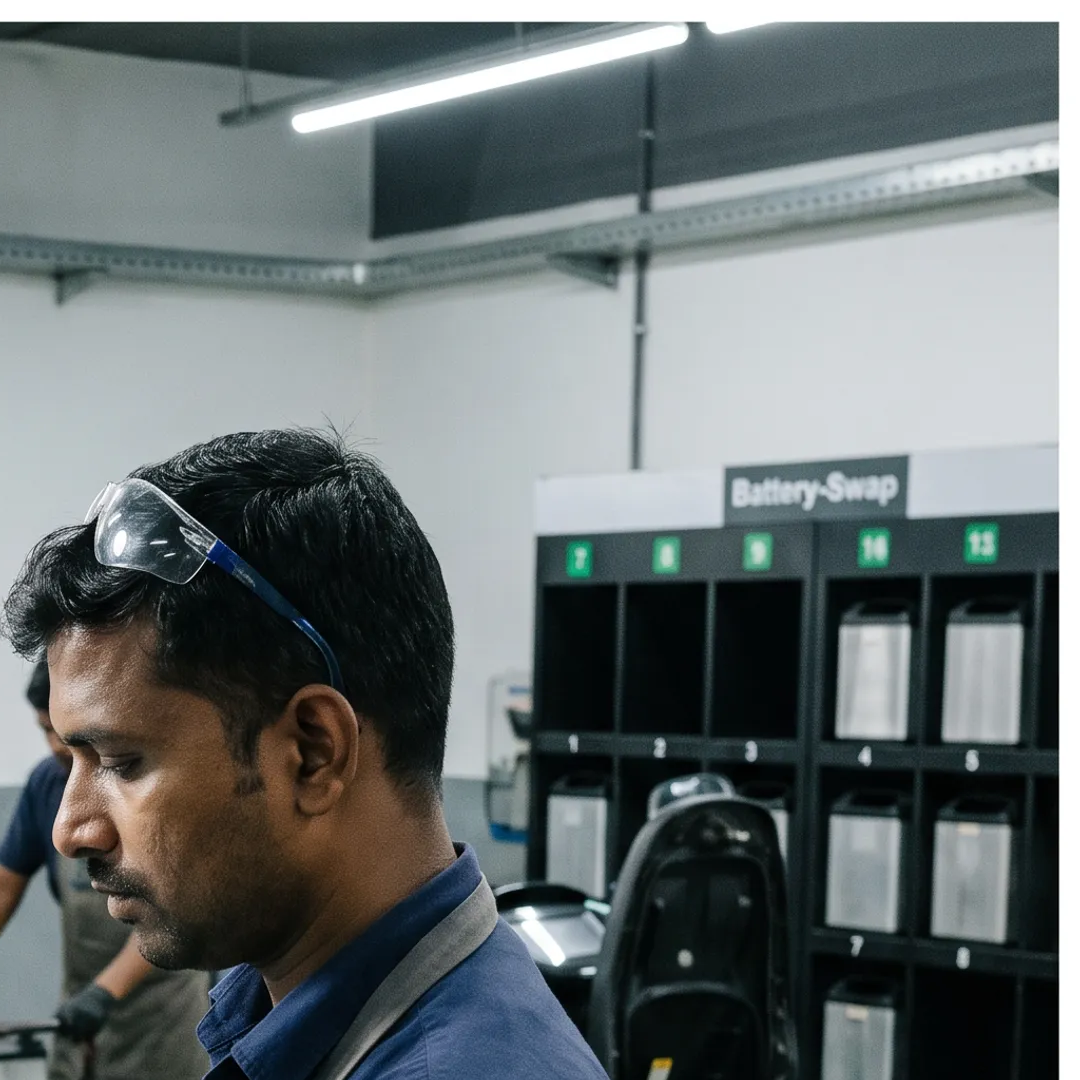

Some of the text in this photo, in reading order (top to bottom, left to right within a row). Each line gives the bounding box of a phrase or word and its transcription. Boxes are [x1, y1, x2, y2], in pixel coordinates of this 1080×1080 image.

[731, 470, 899, 511] Battery-Swap
[568, 735, 579, 754] 1
[653, 737, 667, 759] 2
[744, 740, 758, 762] 3
[857, 745, 872, 767] 4
[850, 935, 864, 957] 7
